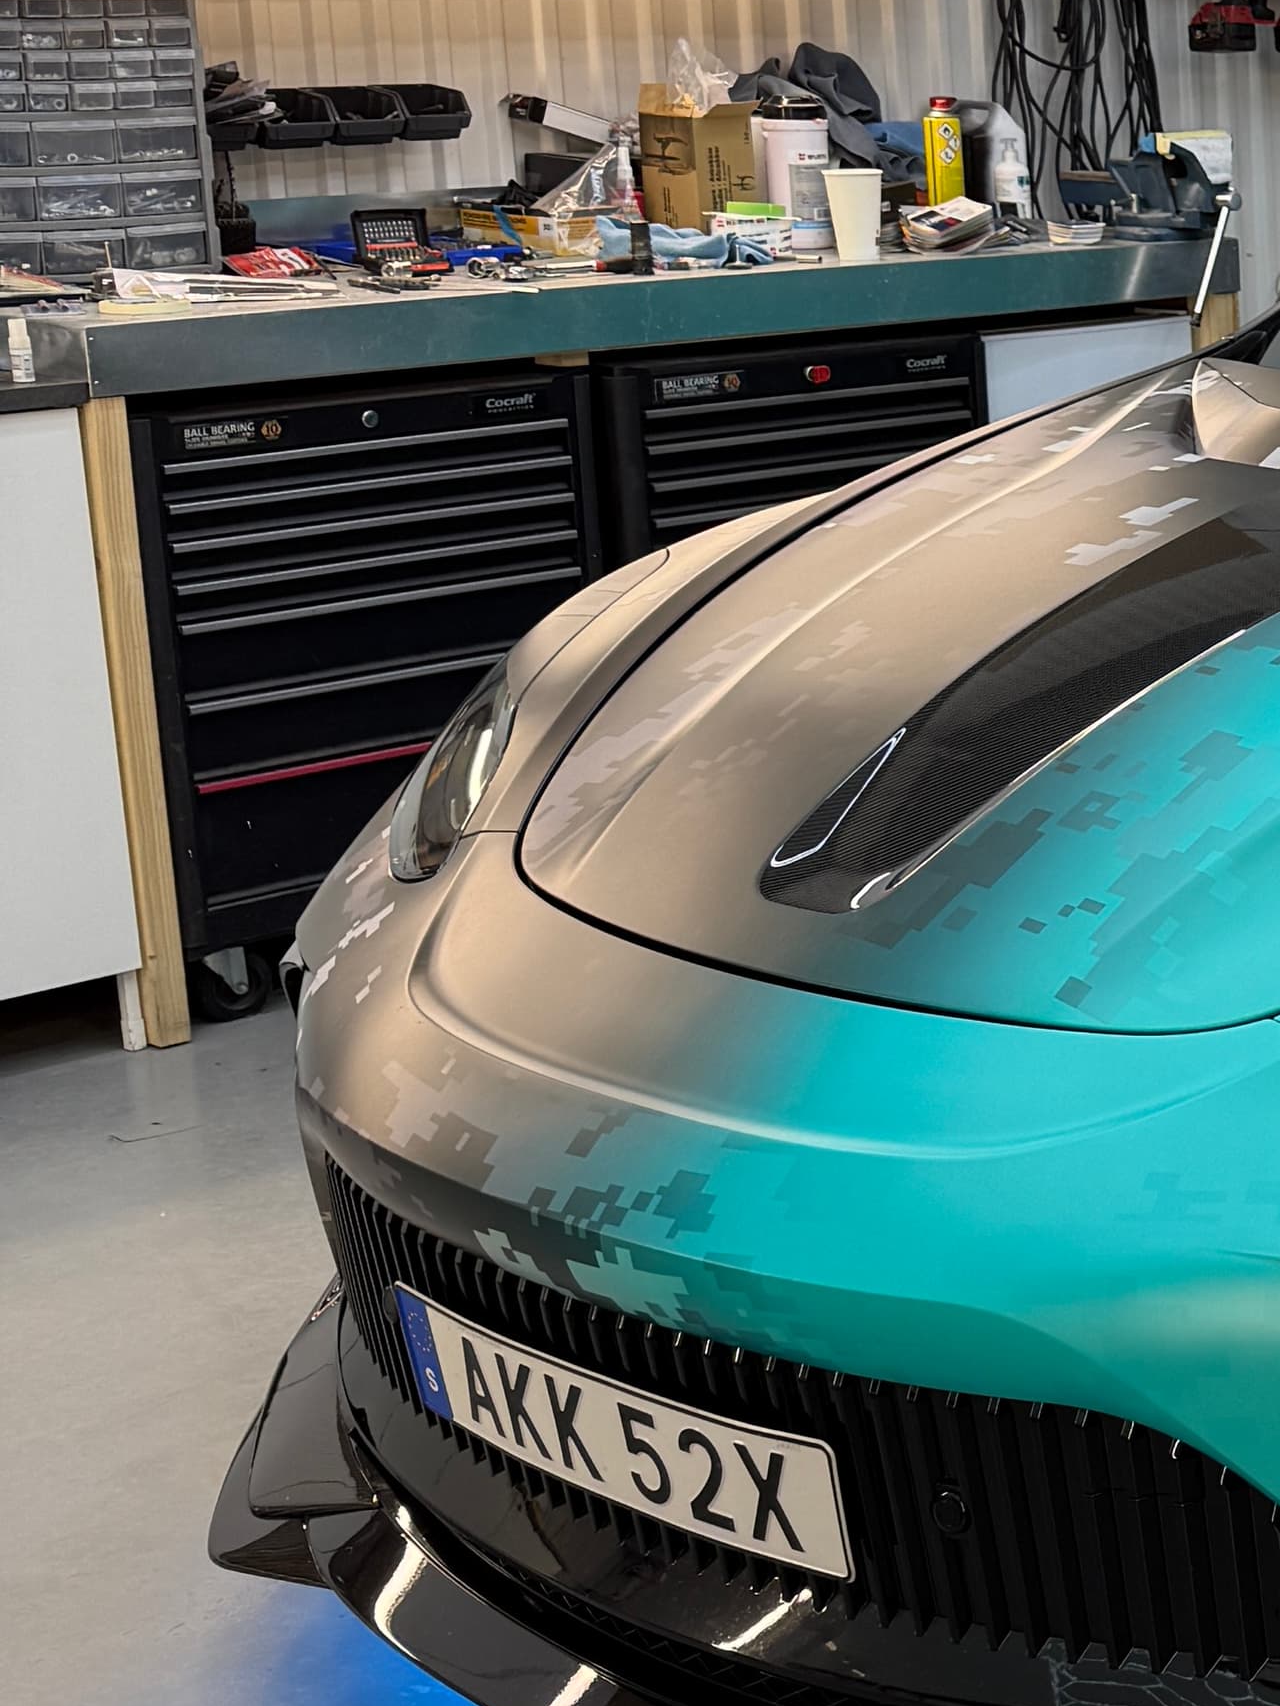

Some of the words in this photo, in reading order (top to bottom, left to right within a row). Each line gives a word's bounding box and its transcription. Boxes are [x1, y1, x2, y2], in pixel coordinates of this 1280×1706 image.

[485, 393, 535, 408] Cocraft
[184, 425, 209, 439] BALL
[210, 421, 256, 436] BEARING
[424, 1367, 440, 1393] S
[461, 1335, 606, 1483] AKK
[617, 1401, 806, 1553] 52X
